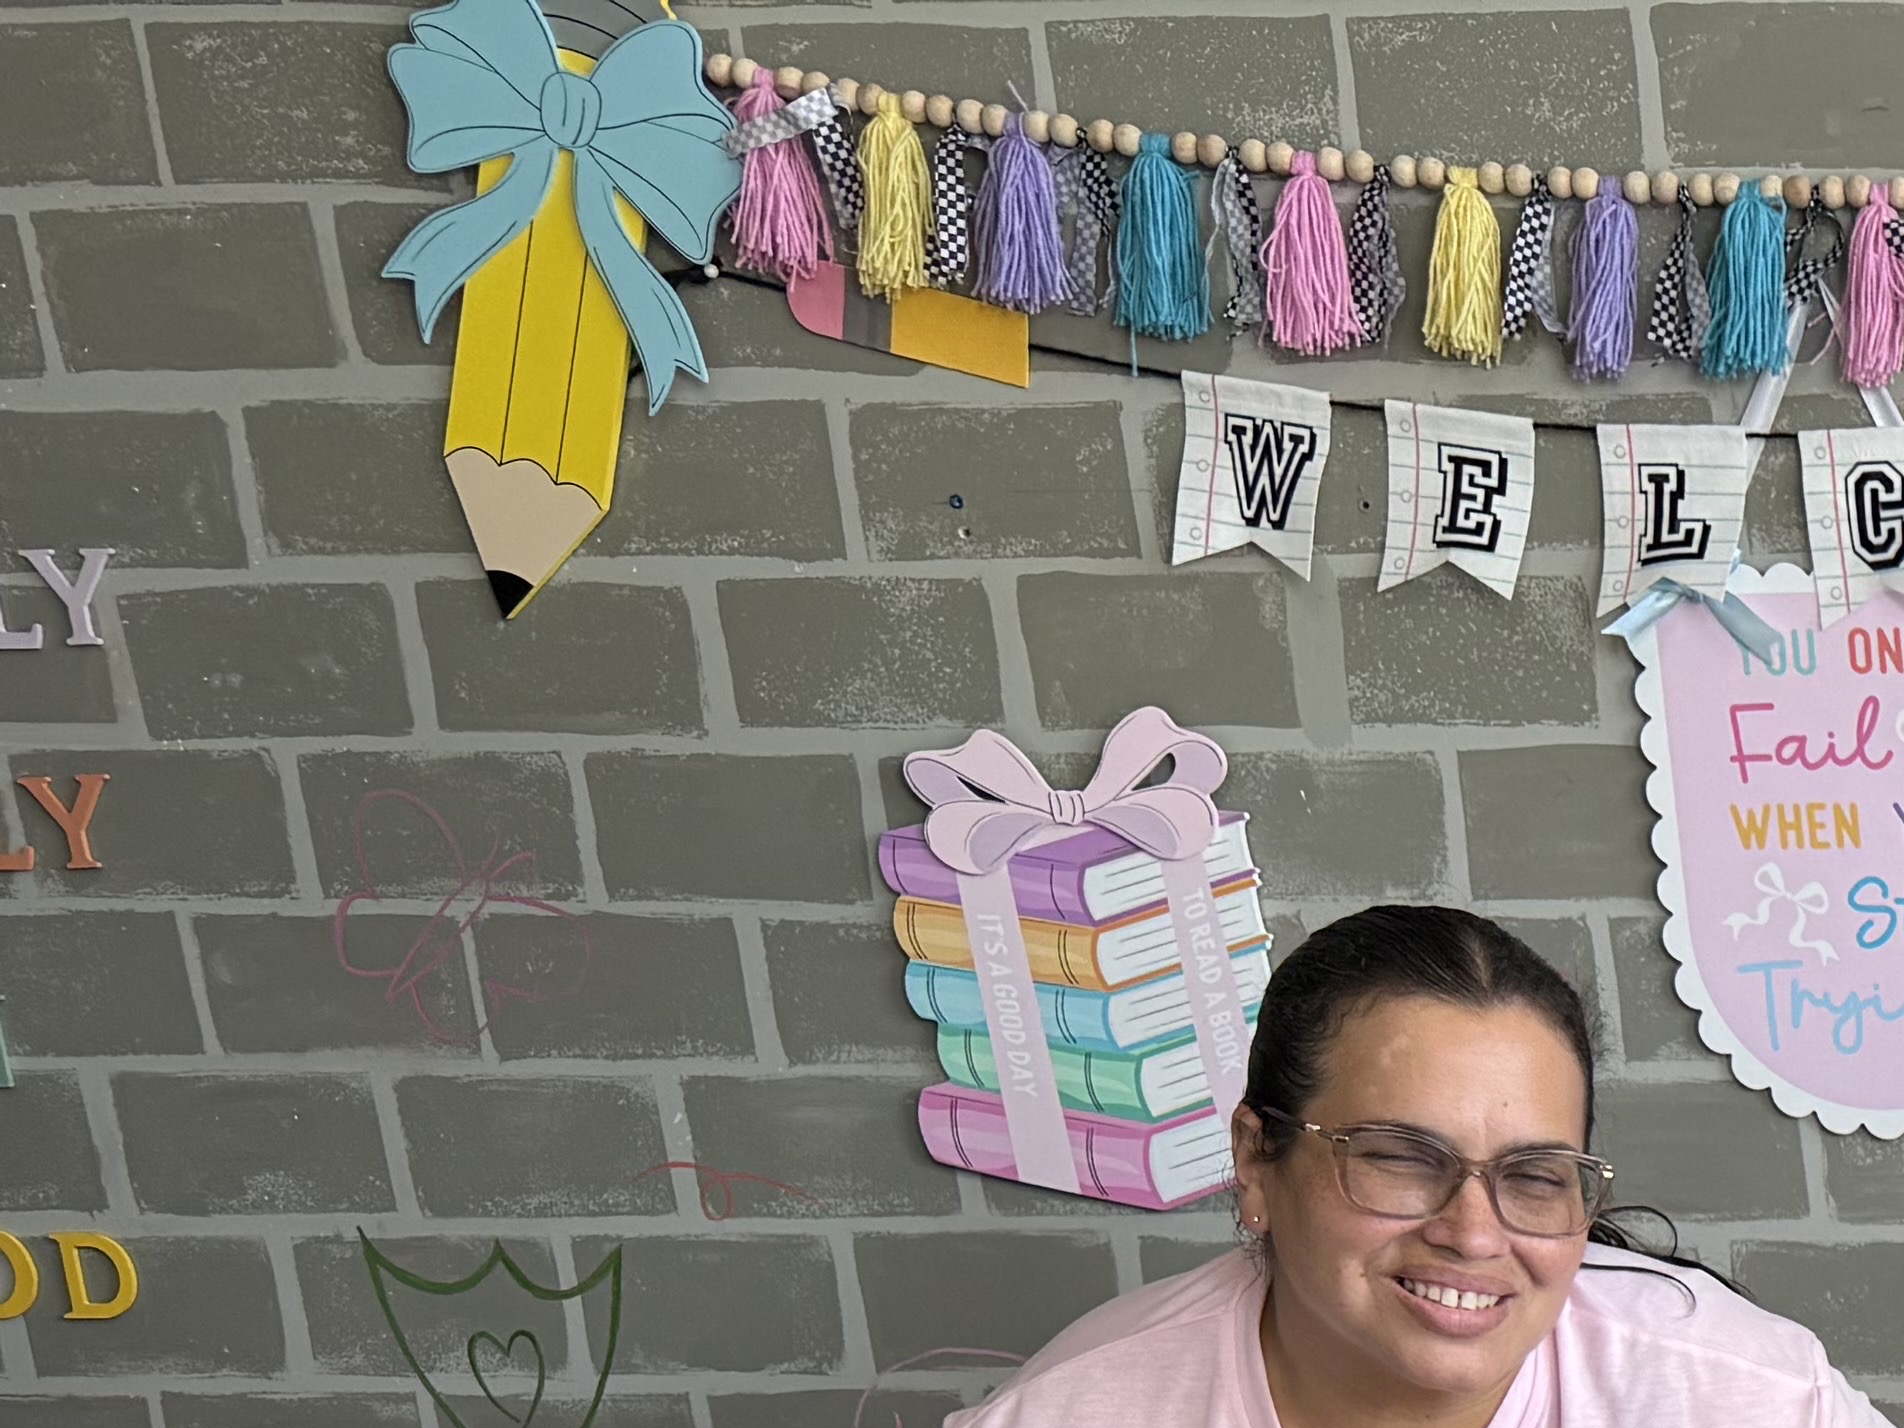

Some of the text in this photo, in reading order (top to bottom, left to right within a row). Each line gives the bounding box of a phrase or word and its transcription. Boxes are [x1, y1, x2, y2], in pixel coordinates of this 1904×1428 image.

[1729, 695, 1894, 784] Fail
[1730, 802, 1862, 849] WHEN
[987, 961, 1013, 977] A
[1182, 887, 1243, 1075] TO READ A BOOK
[992, 984, 1026, 1045] GOOD
[1006, 1050, 1038, 1097] DAY
